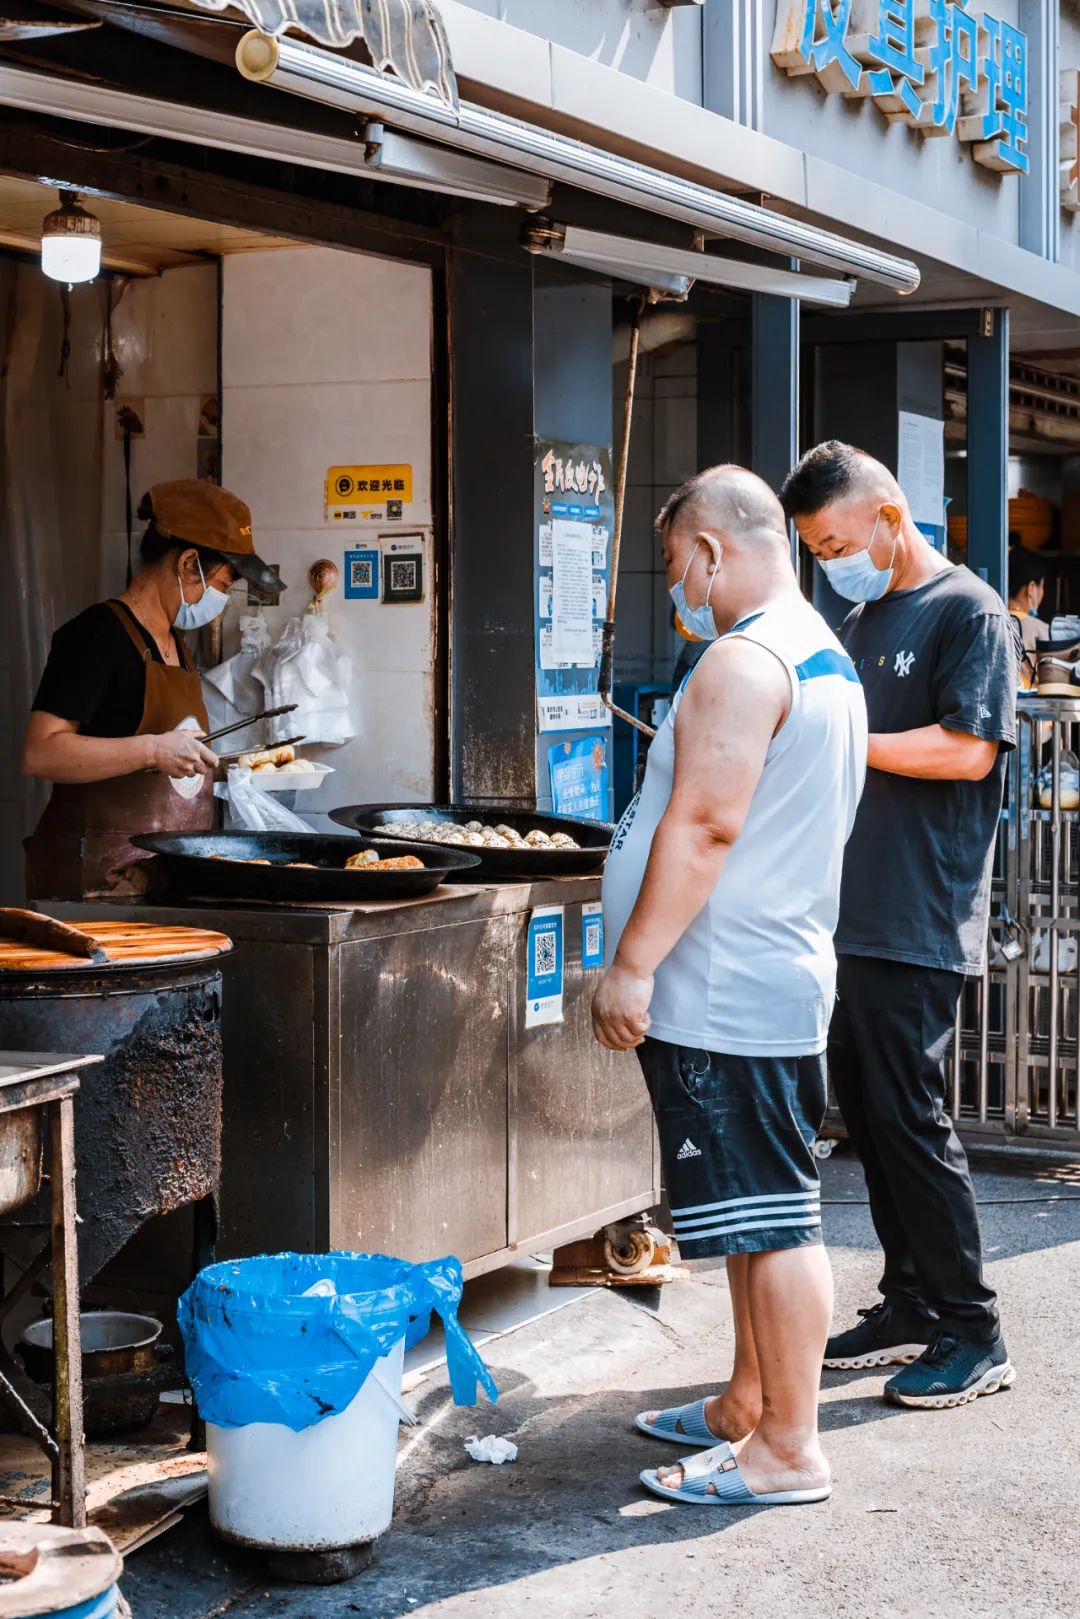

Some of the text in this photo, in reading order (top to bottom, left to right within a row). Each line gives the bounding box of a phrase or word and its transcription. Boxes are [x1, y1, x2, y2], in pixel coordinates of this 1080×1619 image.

[357, 479, 405, 492] 欢迎光临
[677, 1149, 702, 1160] adidas
